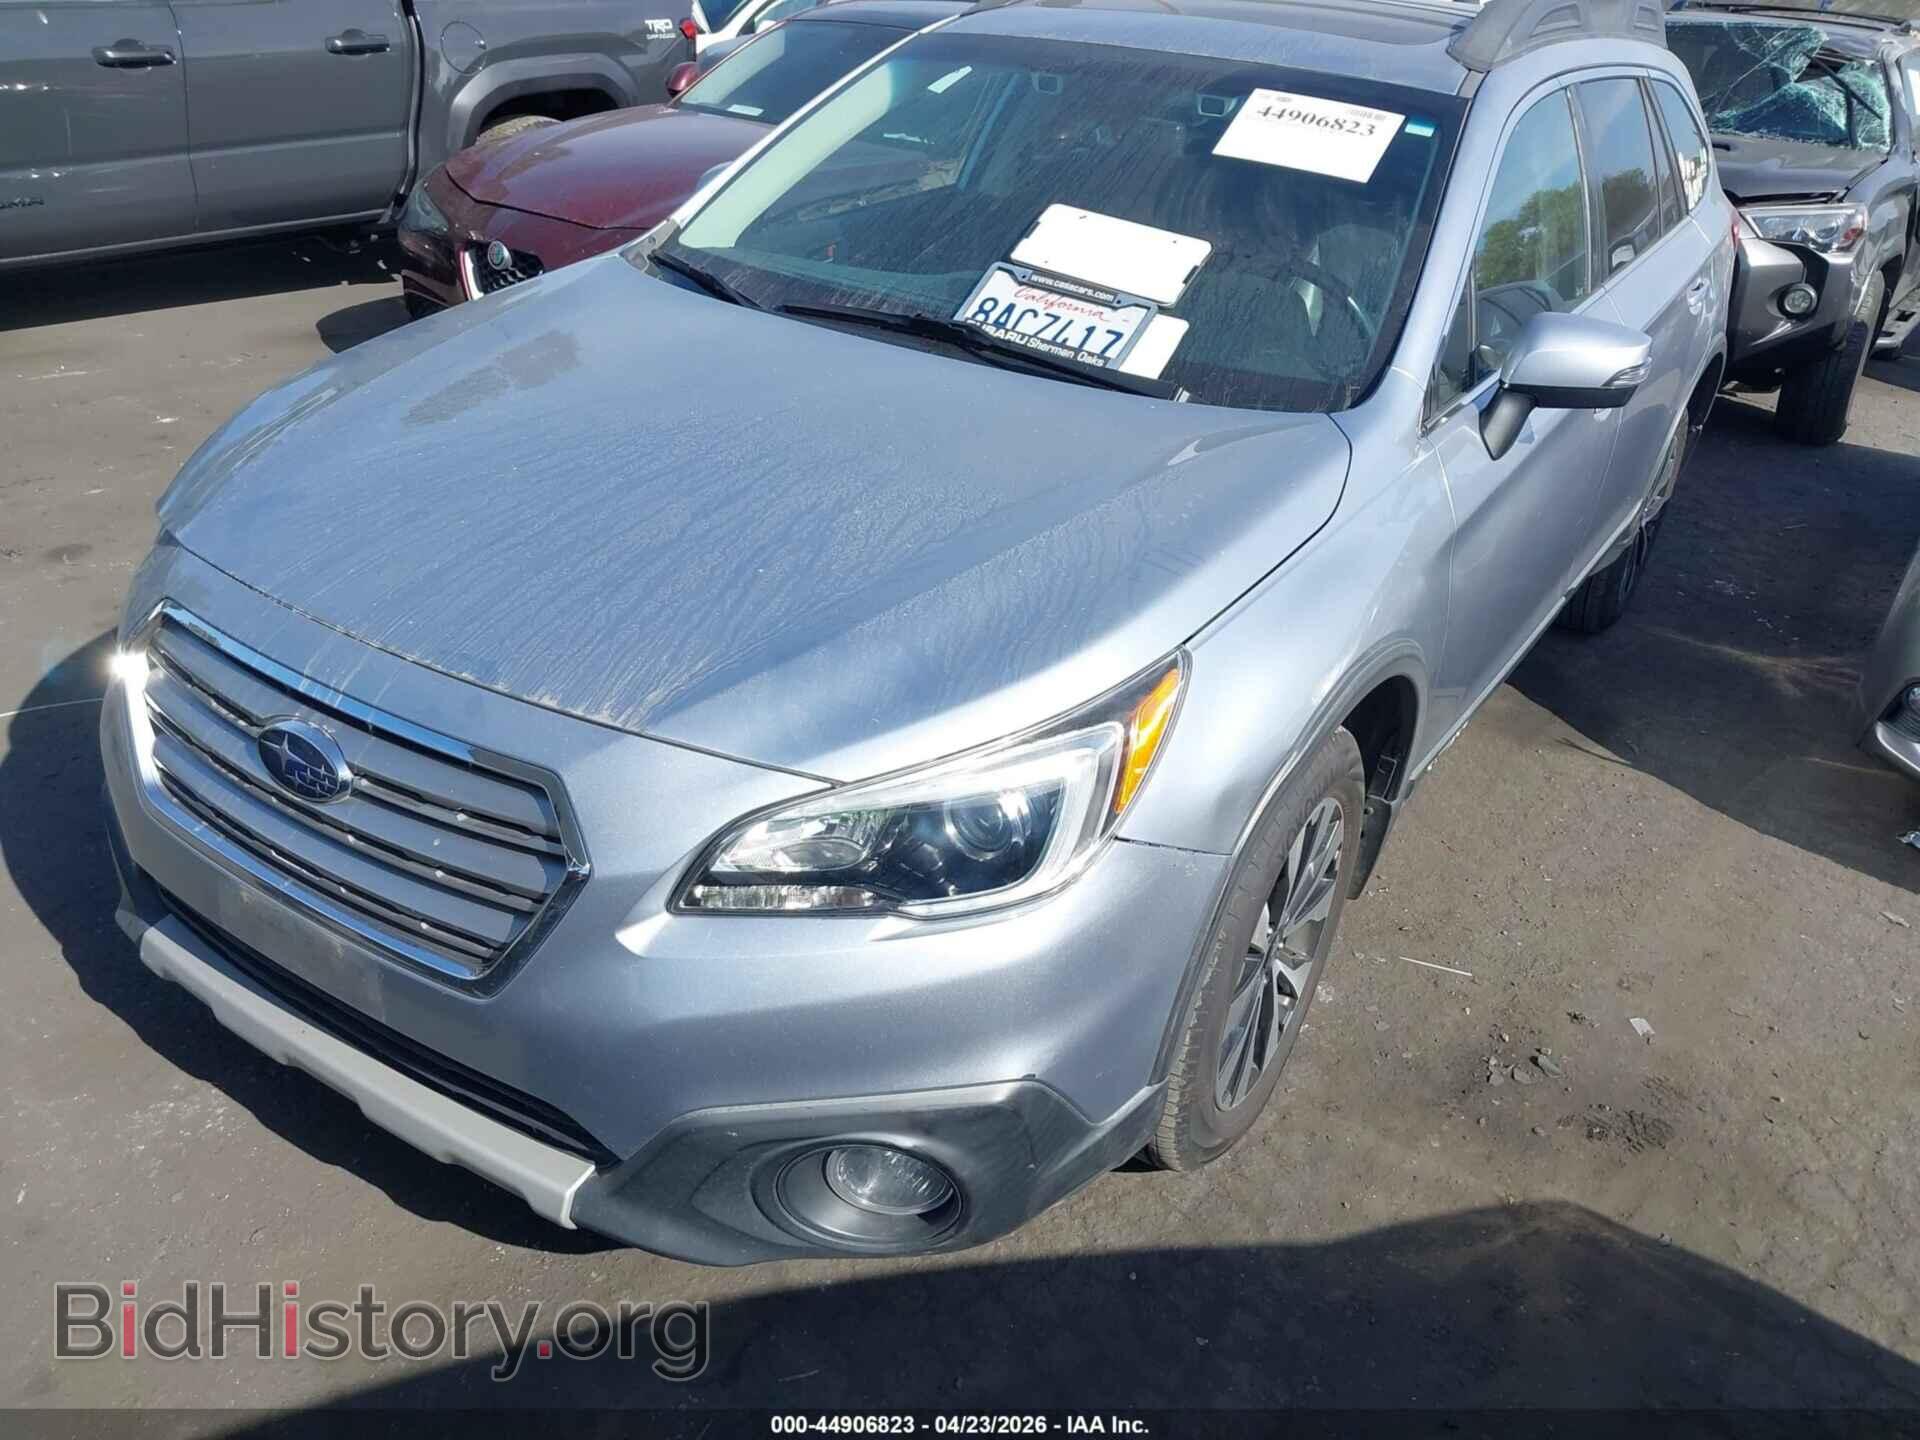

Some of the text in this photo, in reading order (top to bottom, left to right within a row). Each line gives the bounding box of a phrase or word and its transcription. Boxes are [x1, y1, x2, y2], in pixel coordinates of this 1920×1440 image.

[644, 18, 673, 33] TRD
[1256, 104, 1376, 137] 44906823
[1014, 284, 1110, 323] California
[1027, 337, 1075, 359] Sherman
[1077, 351, 1105, 367] Oaks
